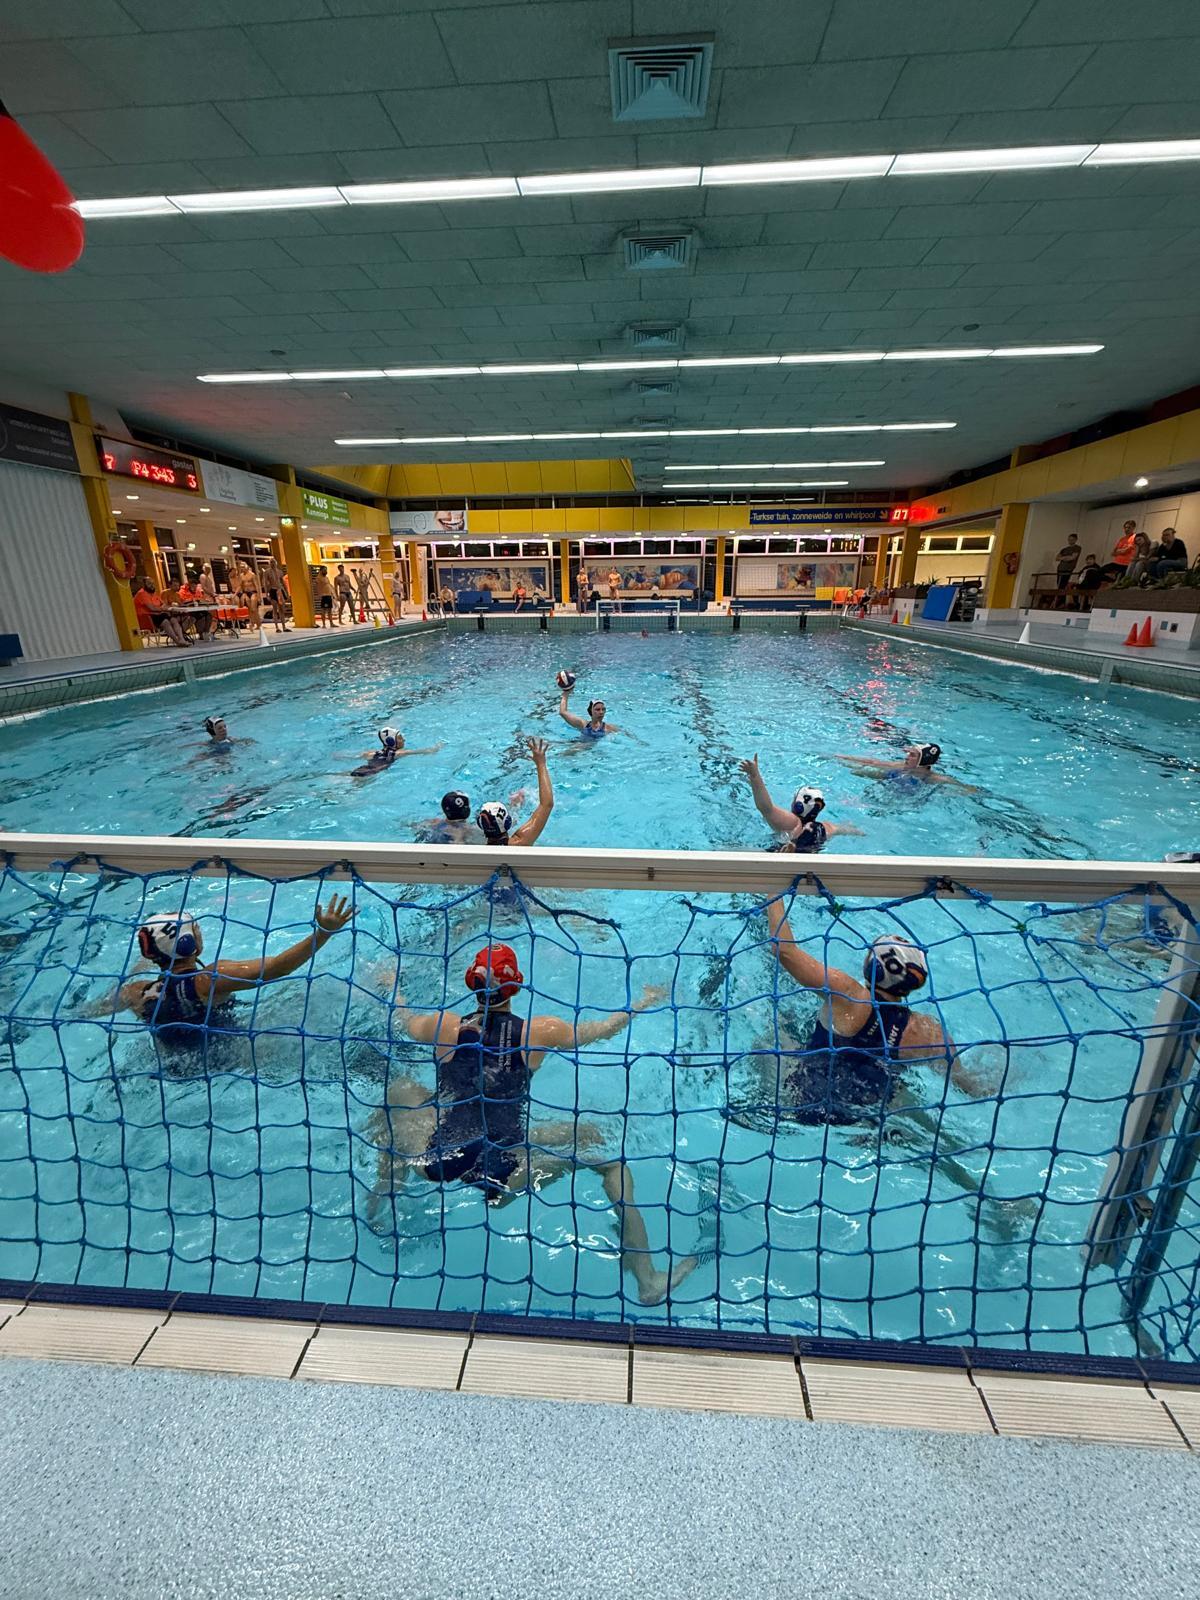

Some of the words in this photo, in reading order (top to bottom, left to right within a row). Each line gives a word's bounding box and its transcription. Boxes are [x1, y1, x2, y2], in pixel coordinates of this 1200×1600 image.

[104, 453, 115, 470] 7
[187, 474, 197, 489] 3
[310, 495, 329, 510] PLUS
[752, 512, 775, 521] Turkse
[776, 511, 790, 521] tuin,
[792, 511, 833, 520] zonneweide
[834, 512, 844, 520] en
[845, 510, 877, 521] whirlpool
[893, 509, 909, 520] 07
[455, 797, 464, 807] 9
[161, 922, 177, 939] 5
[881, 947, 904, 975] 10
